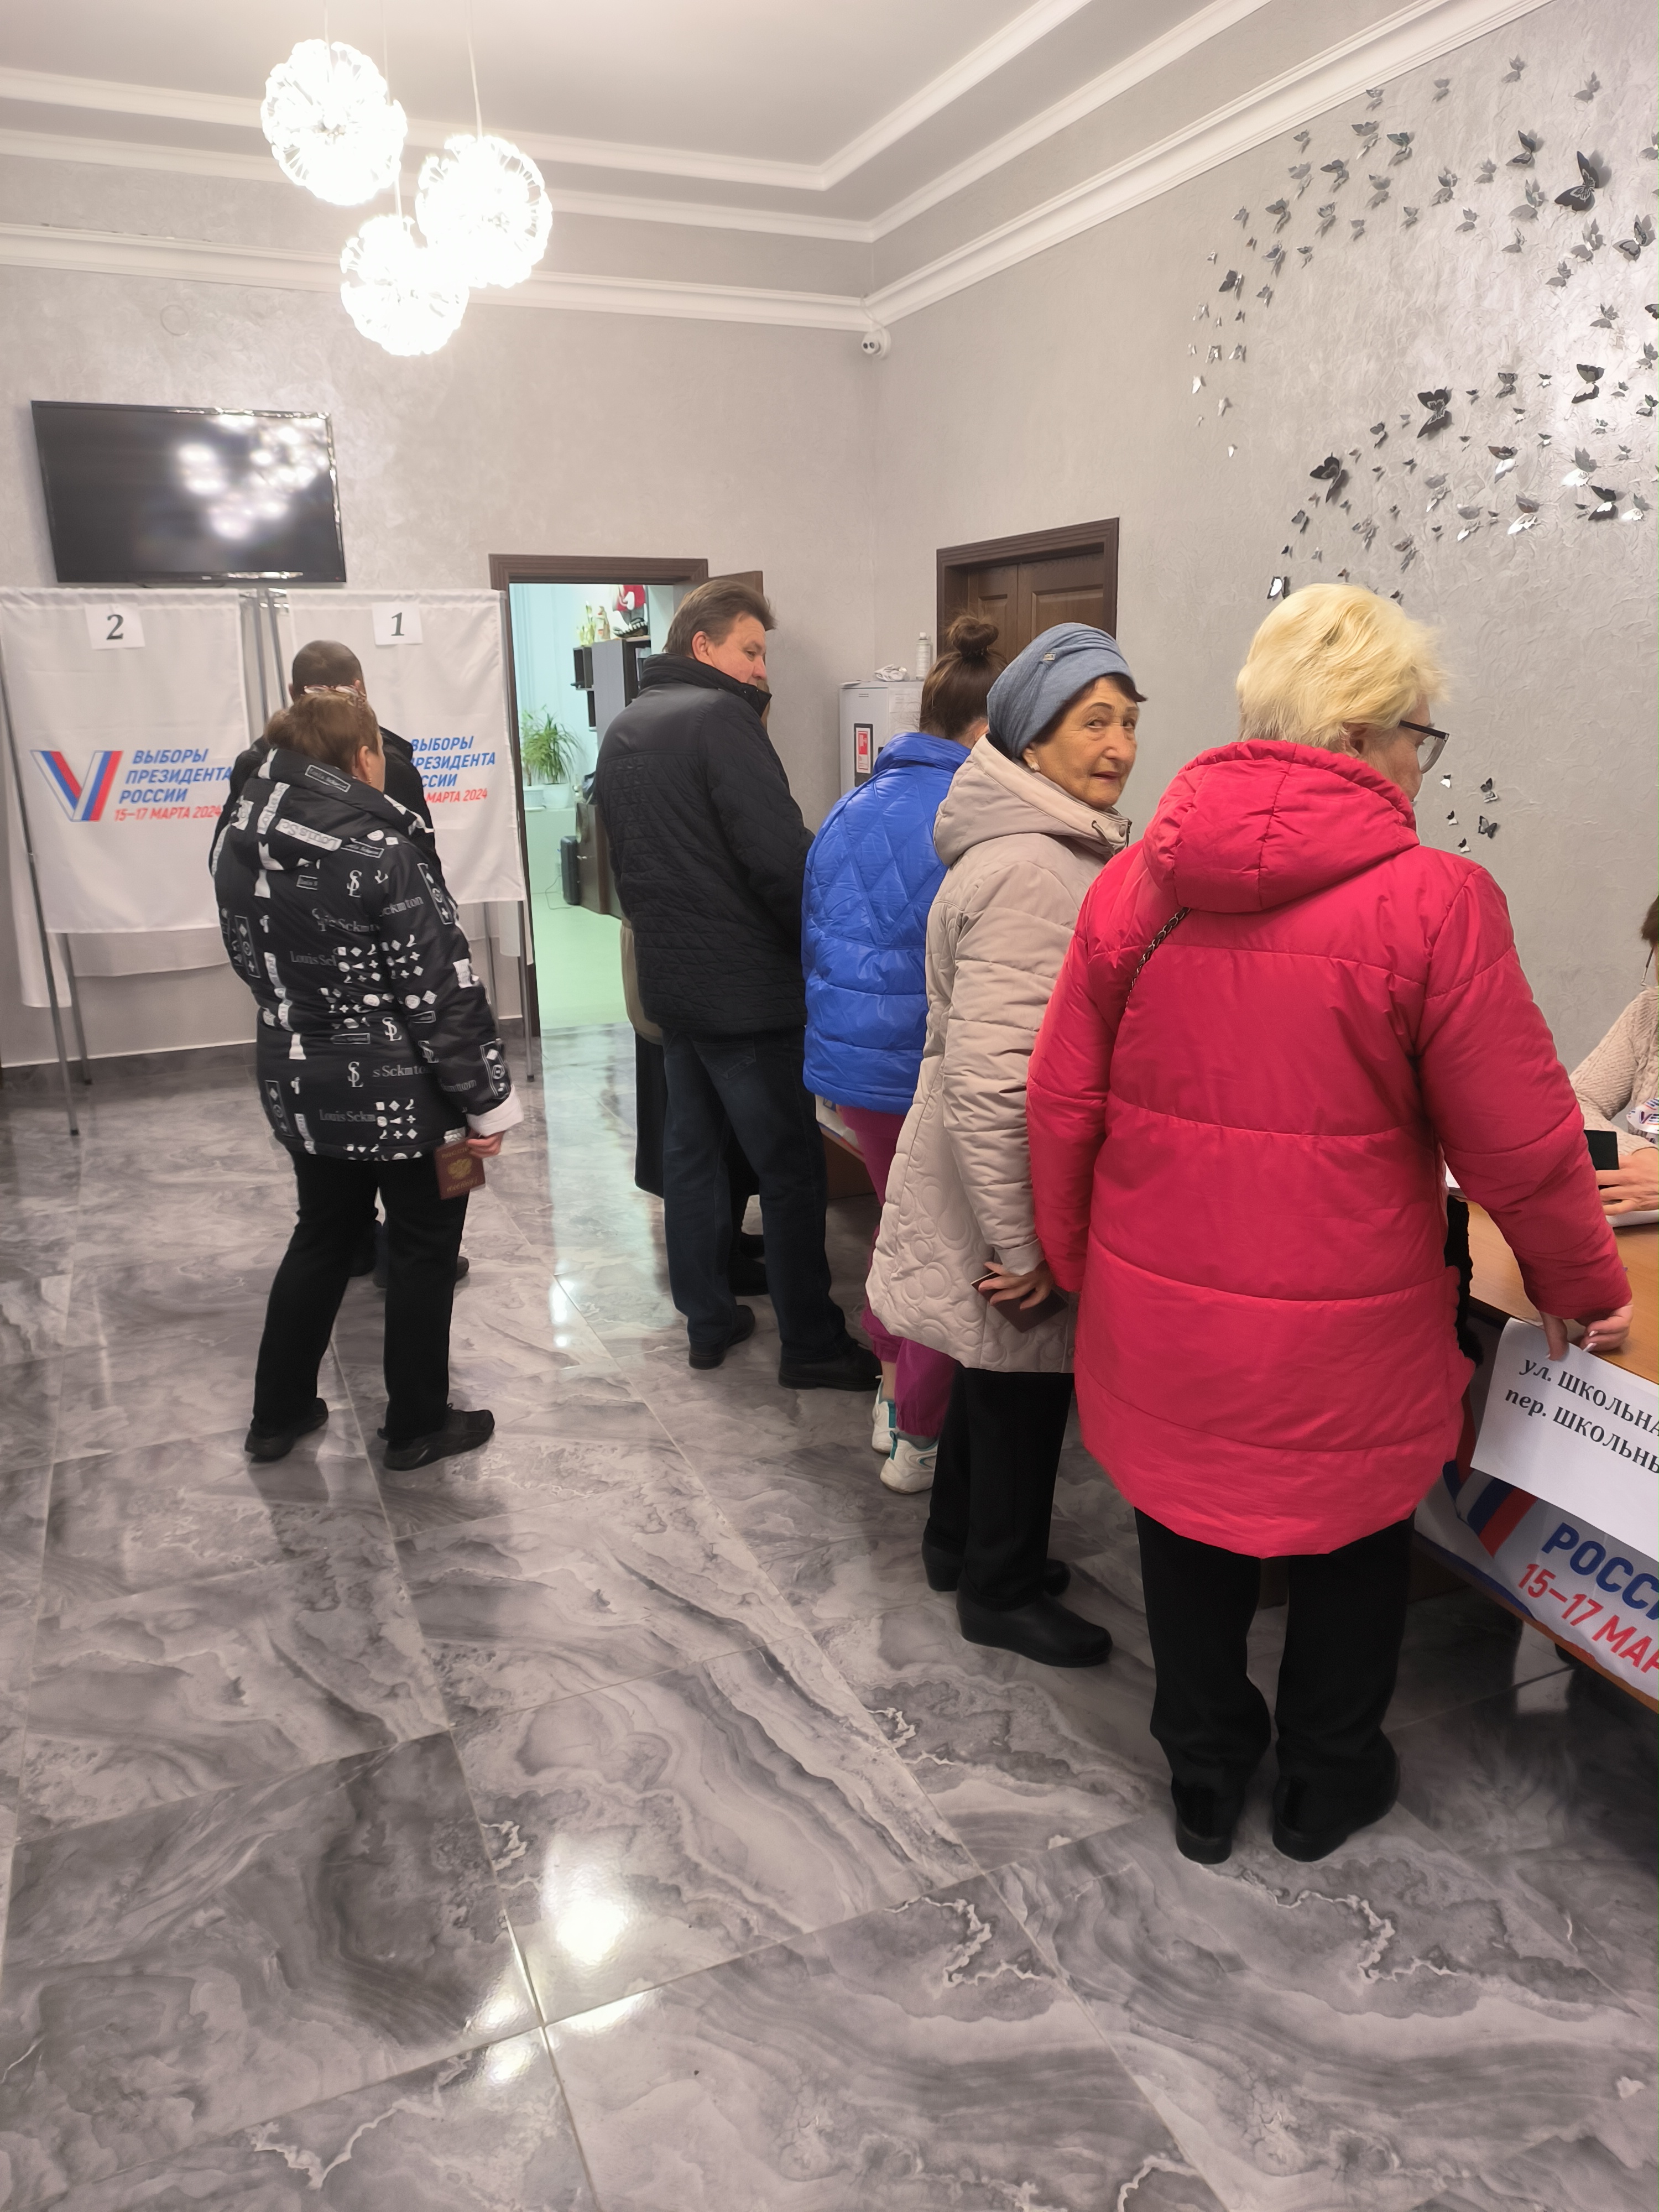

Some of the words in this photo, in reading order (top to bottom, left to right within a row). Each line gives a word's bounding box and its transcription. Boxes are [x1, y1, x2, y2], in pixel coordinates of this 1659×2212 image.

[106, 614, 124, 640] 2
[391, 612, 405, 636] 1
[410, 736, 474, 752] ВЫБОРЫ
[132, 749, 209, 765] ВЫБОРЫ
[411, 752, 495, 770] РЕЗИДЕНТА
[125, 766, 232, 785] ПРЕЗИДЕНТА
[421, 774, 457, 788] ССИИ
[119, 789, 188, 804] РОССИИ
[426, 791, 461, 804] МАРТА
[463, 788, 488, 802] 2024
[149, 807, 190, 820] МАРТА
[192, 805, 222, 819] 2024
[1505, 1389, 1547, 1417] пер.
[1519, 1359, 1552, 1382] ул.
[1557, 1371, 1659, 1437] ШКОЛЬНА
[1541, 1522, 1659, 1620] РОСС
